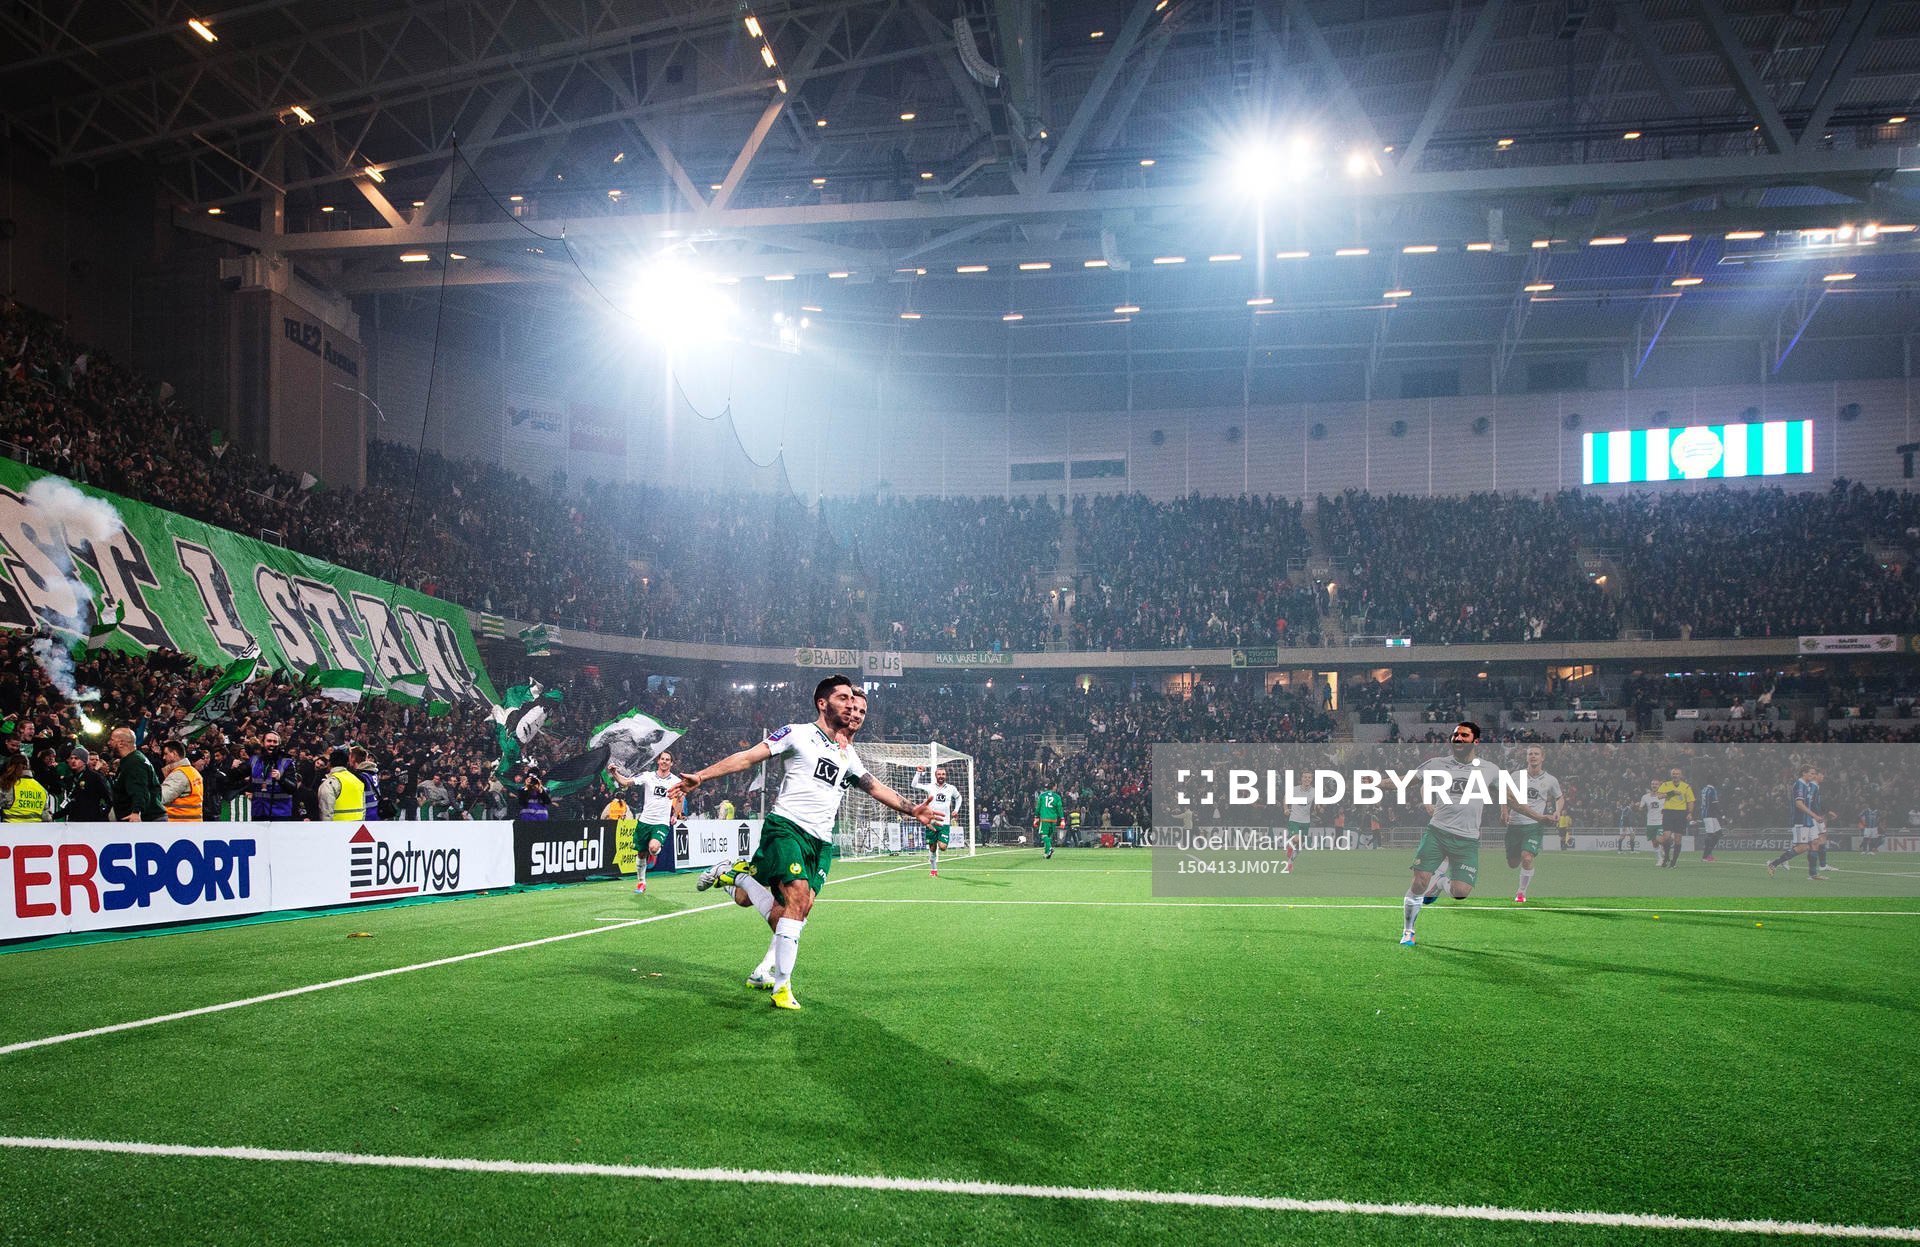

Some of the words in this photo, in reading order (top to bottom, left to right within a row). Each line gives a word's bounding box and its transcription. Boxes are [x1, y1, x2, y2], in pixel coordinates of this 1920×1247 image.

[283, 317, 322, 357] TELE2
[173, 536, 270, 670] I
[814, 650, 856, 665] BAJEN
[18, 799, 44, 809] SERVICE
[20, 790, 42, 799] PUBLIK
[1044, 795, 1054, 808] 12
[530, 827, 604, 877] swedol
[376, 841, 461, 891] Botrygg
